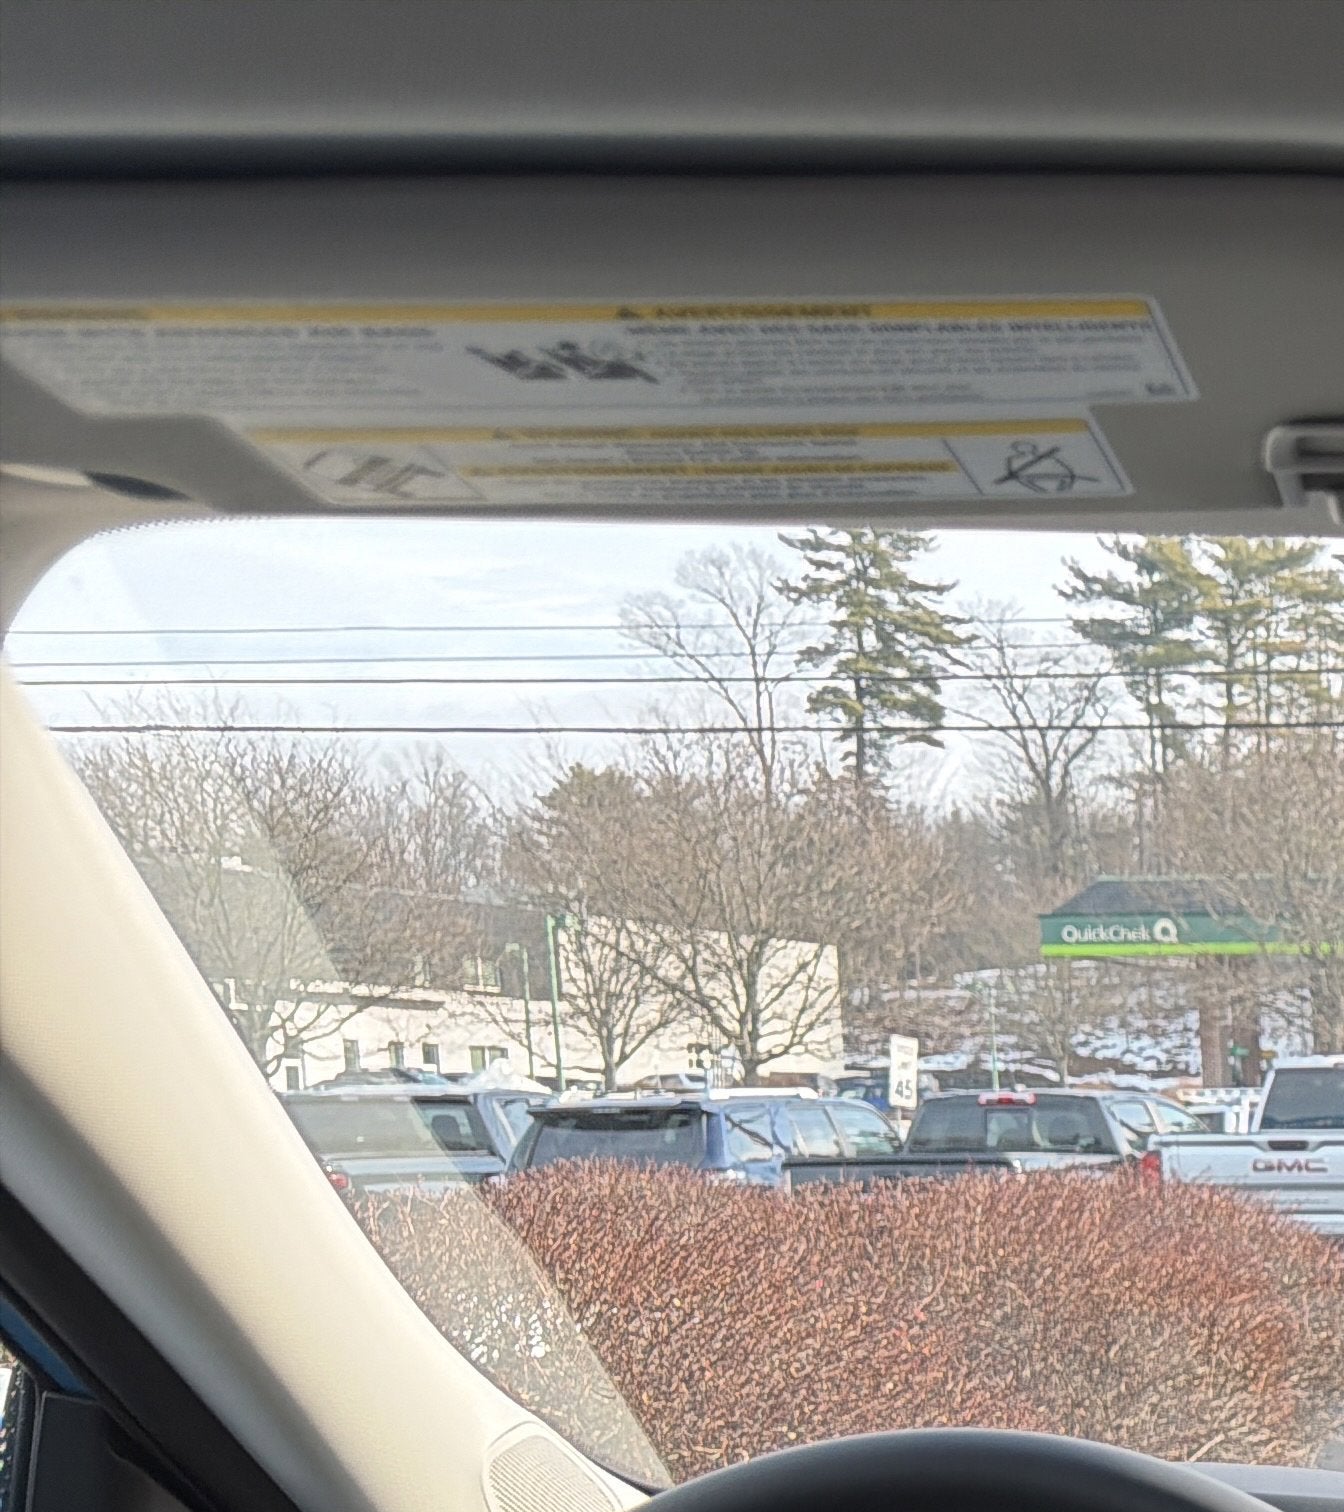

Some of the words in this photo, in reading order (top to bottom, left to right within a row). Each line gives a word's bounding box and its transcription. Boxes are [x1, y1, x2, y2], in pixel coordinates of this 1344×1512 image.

[1060, 923, 1150, 943] QuickChek
[894, 1079, 913, 1100] 45
[1252, 1158, 1329, 1174] GMC
